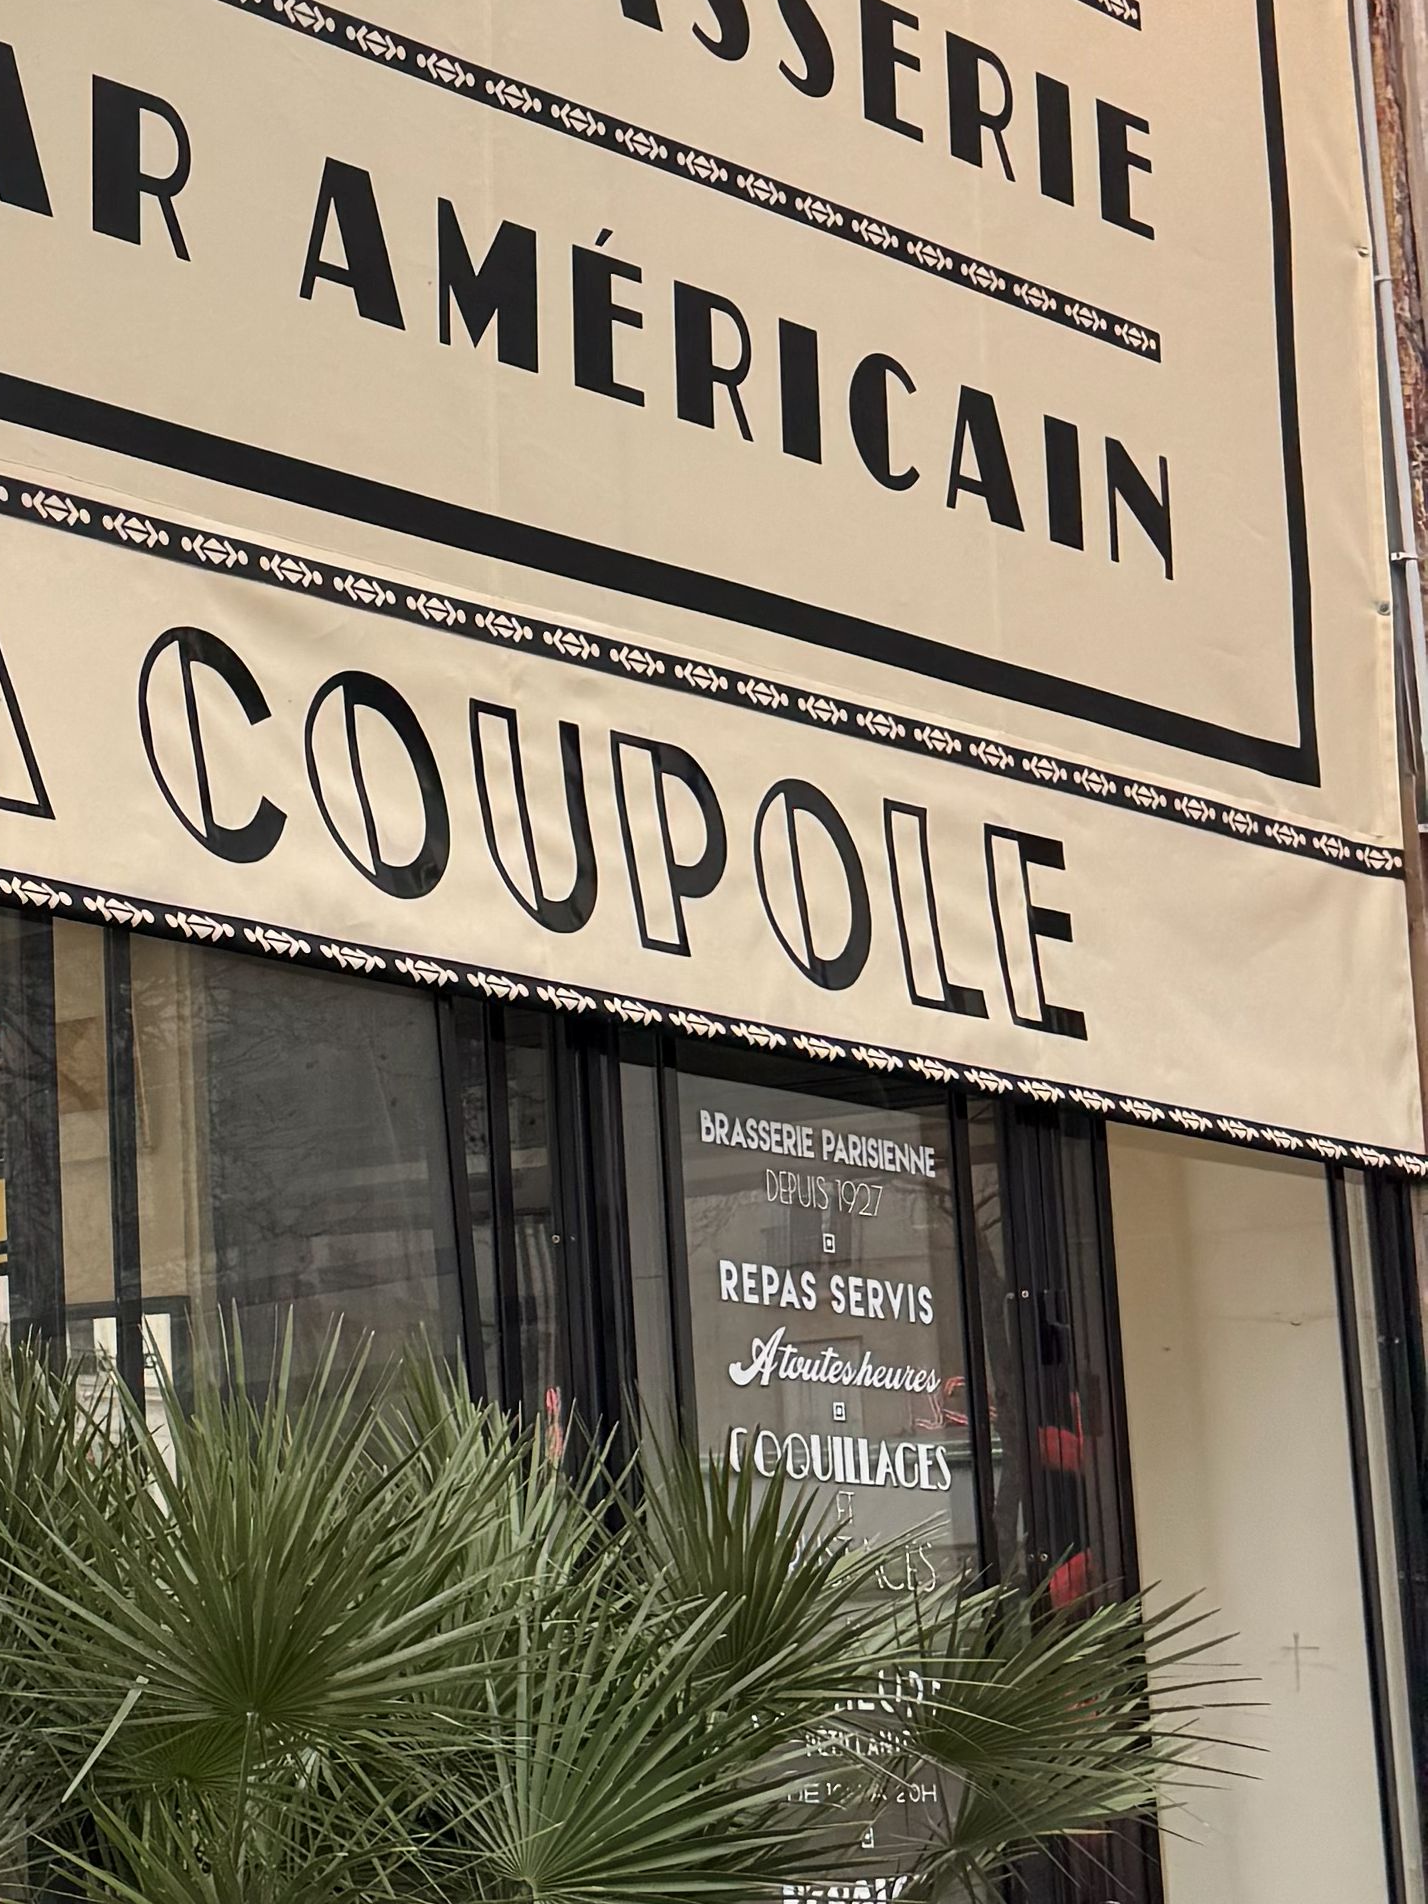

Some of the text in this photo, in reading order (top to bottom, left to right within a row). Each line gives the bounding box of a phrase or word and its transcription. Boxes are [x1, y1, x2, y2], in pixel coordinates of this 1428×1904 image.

[299, 159, 1175, 582] AMÉRICAIN
[138, 625, 1087, 1039] COUPOLE
[700, 1109, 936, 1178] BRASSERIE PARISIENNE
[766, 1168, 883, 1217] DEPUIS 1927
[719, 1259, 934, 1325] REPAS SERVIS
[729, 1427, 952, 1491] COQUILLAGES
